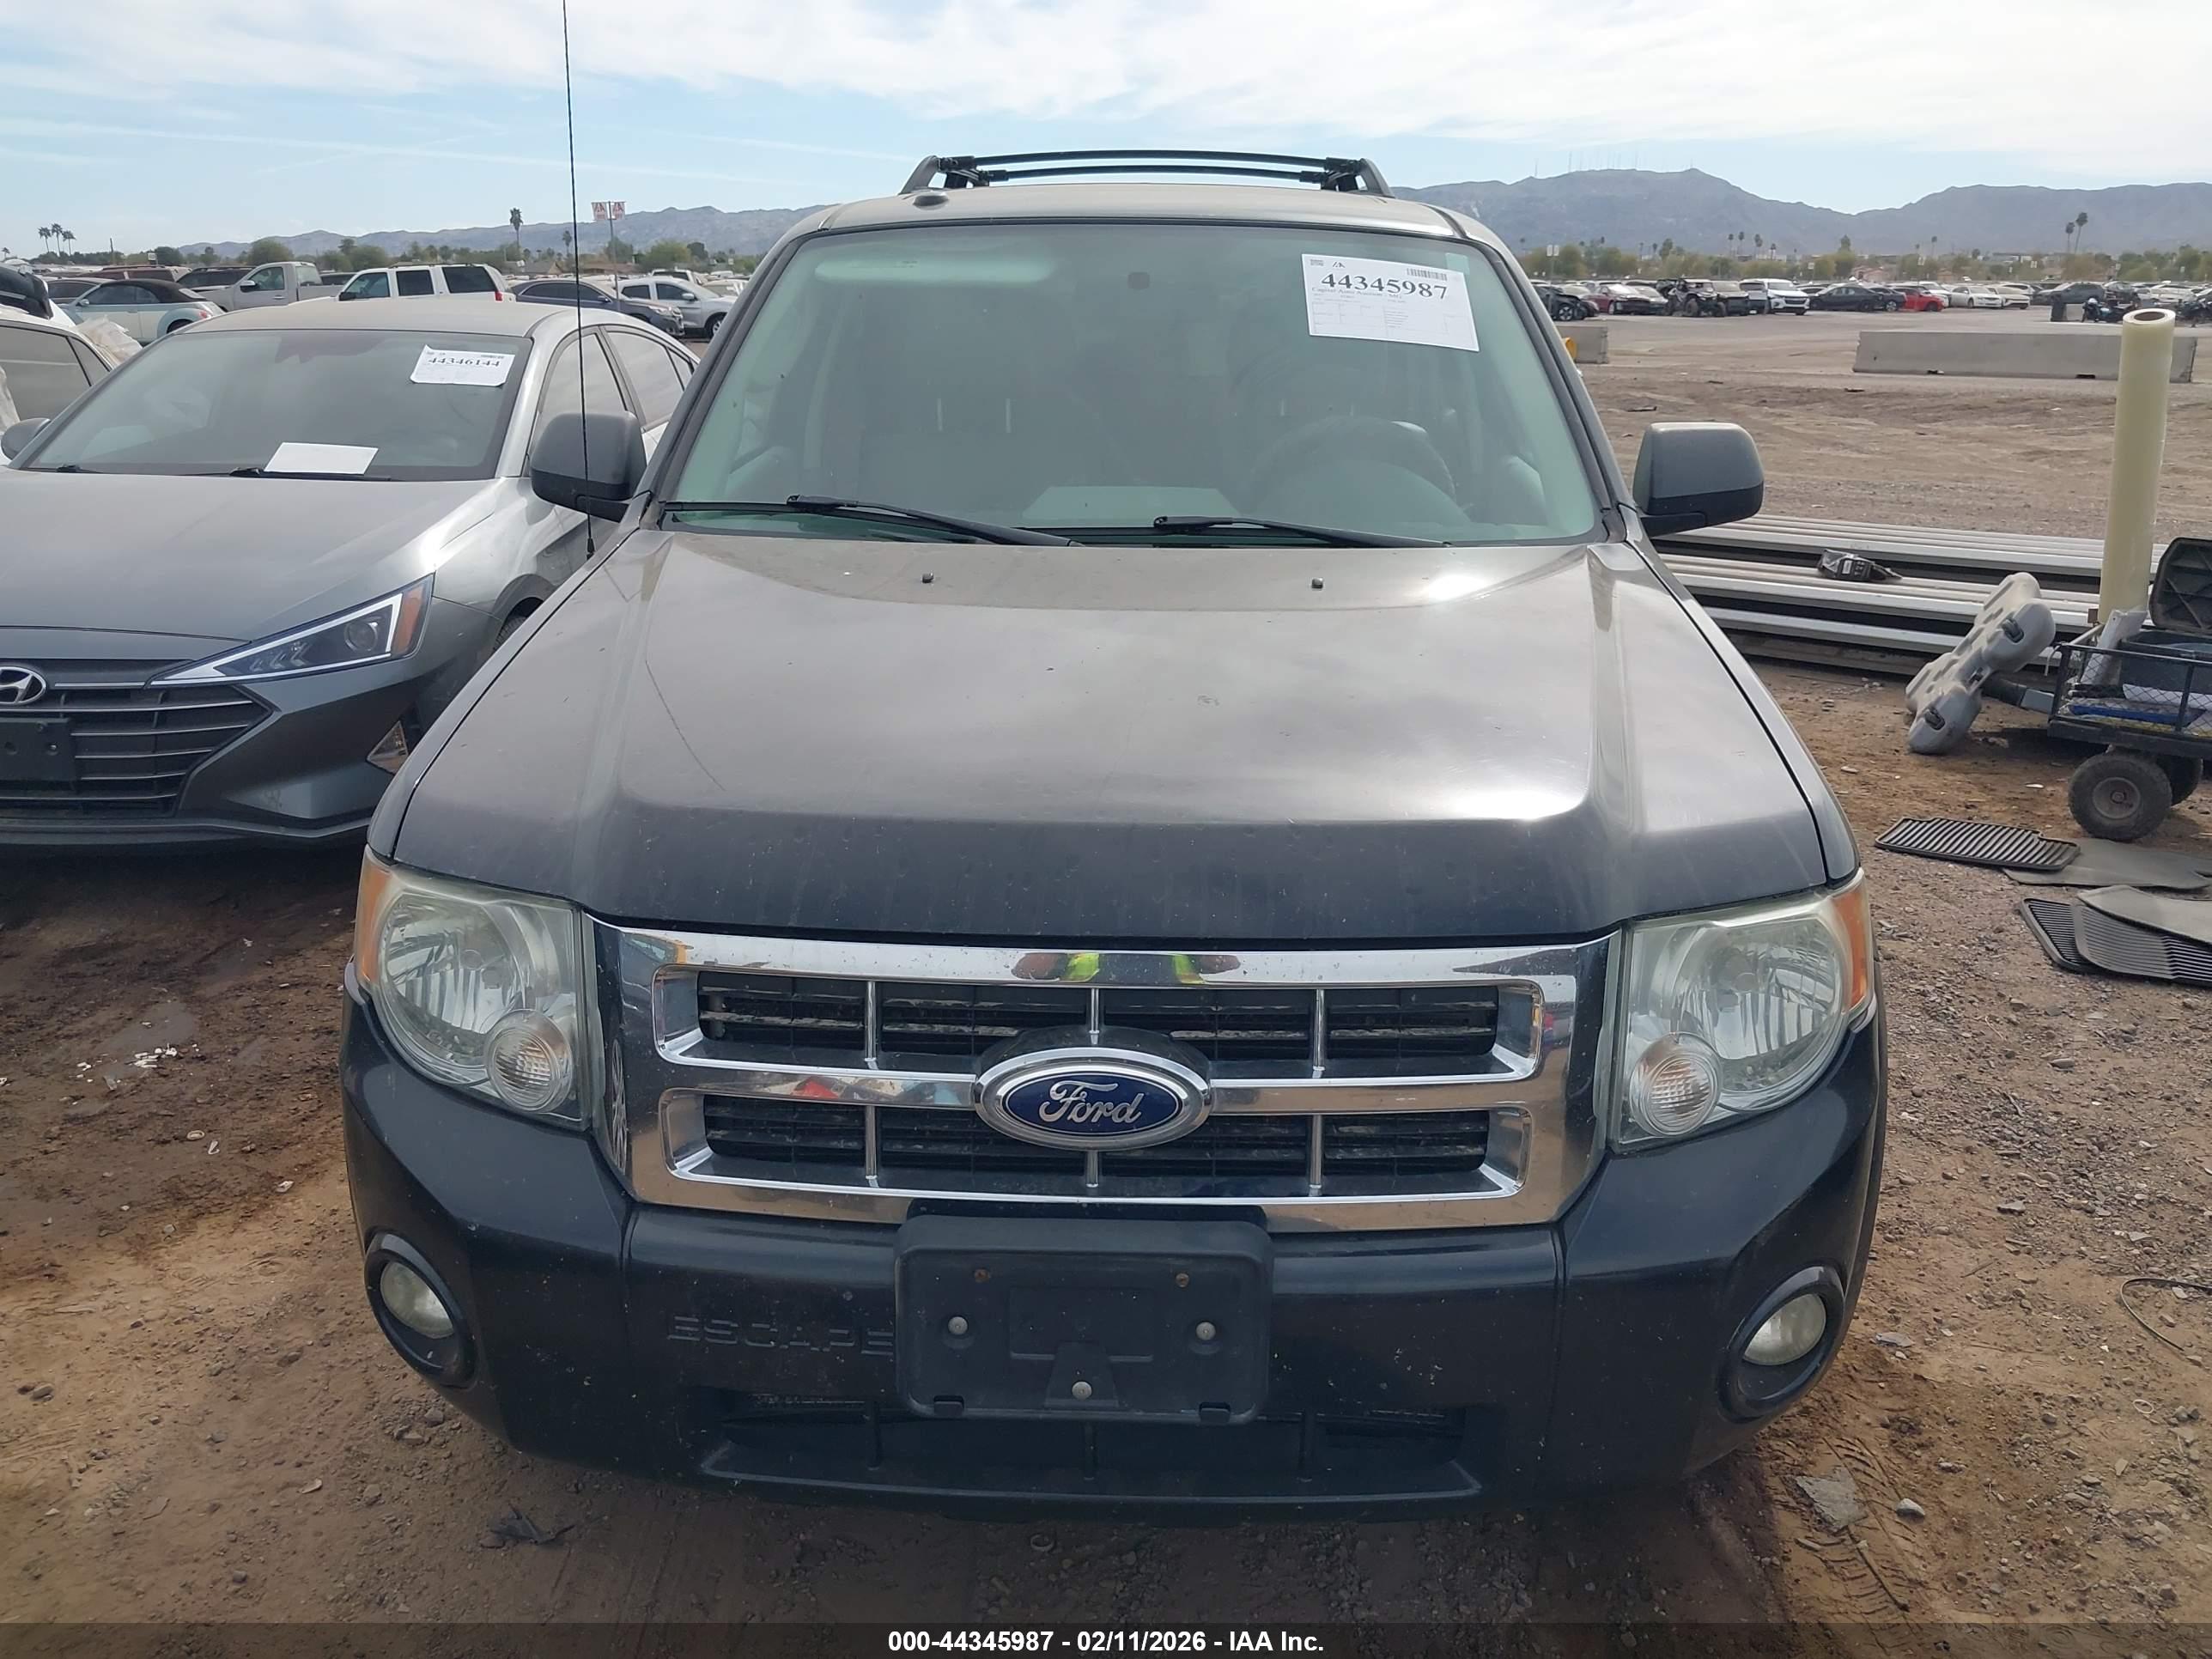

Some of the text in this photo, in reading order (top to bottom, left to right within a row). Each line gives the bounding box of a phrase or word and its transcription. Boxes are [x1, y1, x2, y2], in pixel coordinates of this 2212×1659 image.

[1321, 273, 1448, 300] 44345987
[428, 357, 500, 367] 44346144
[1038, 1079, 1145, 1123] Ford
[667, 1316, 894, 1356] ESCAPE
